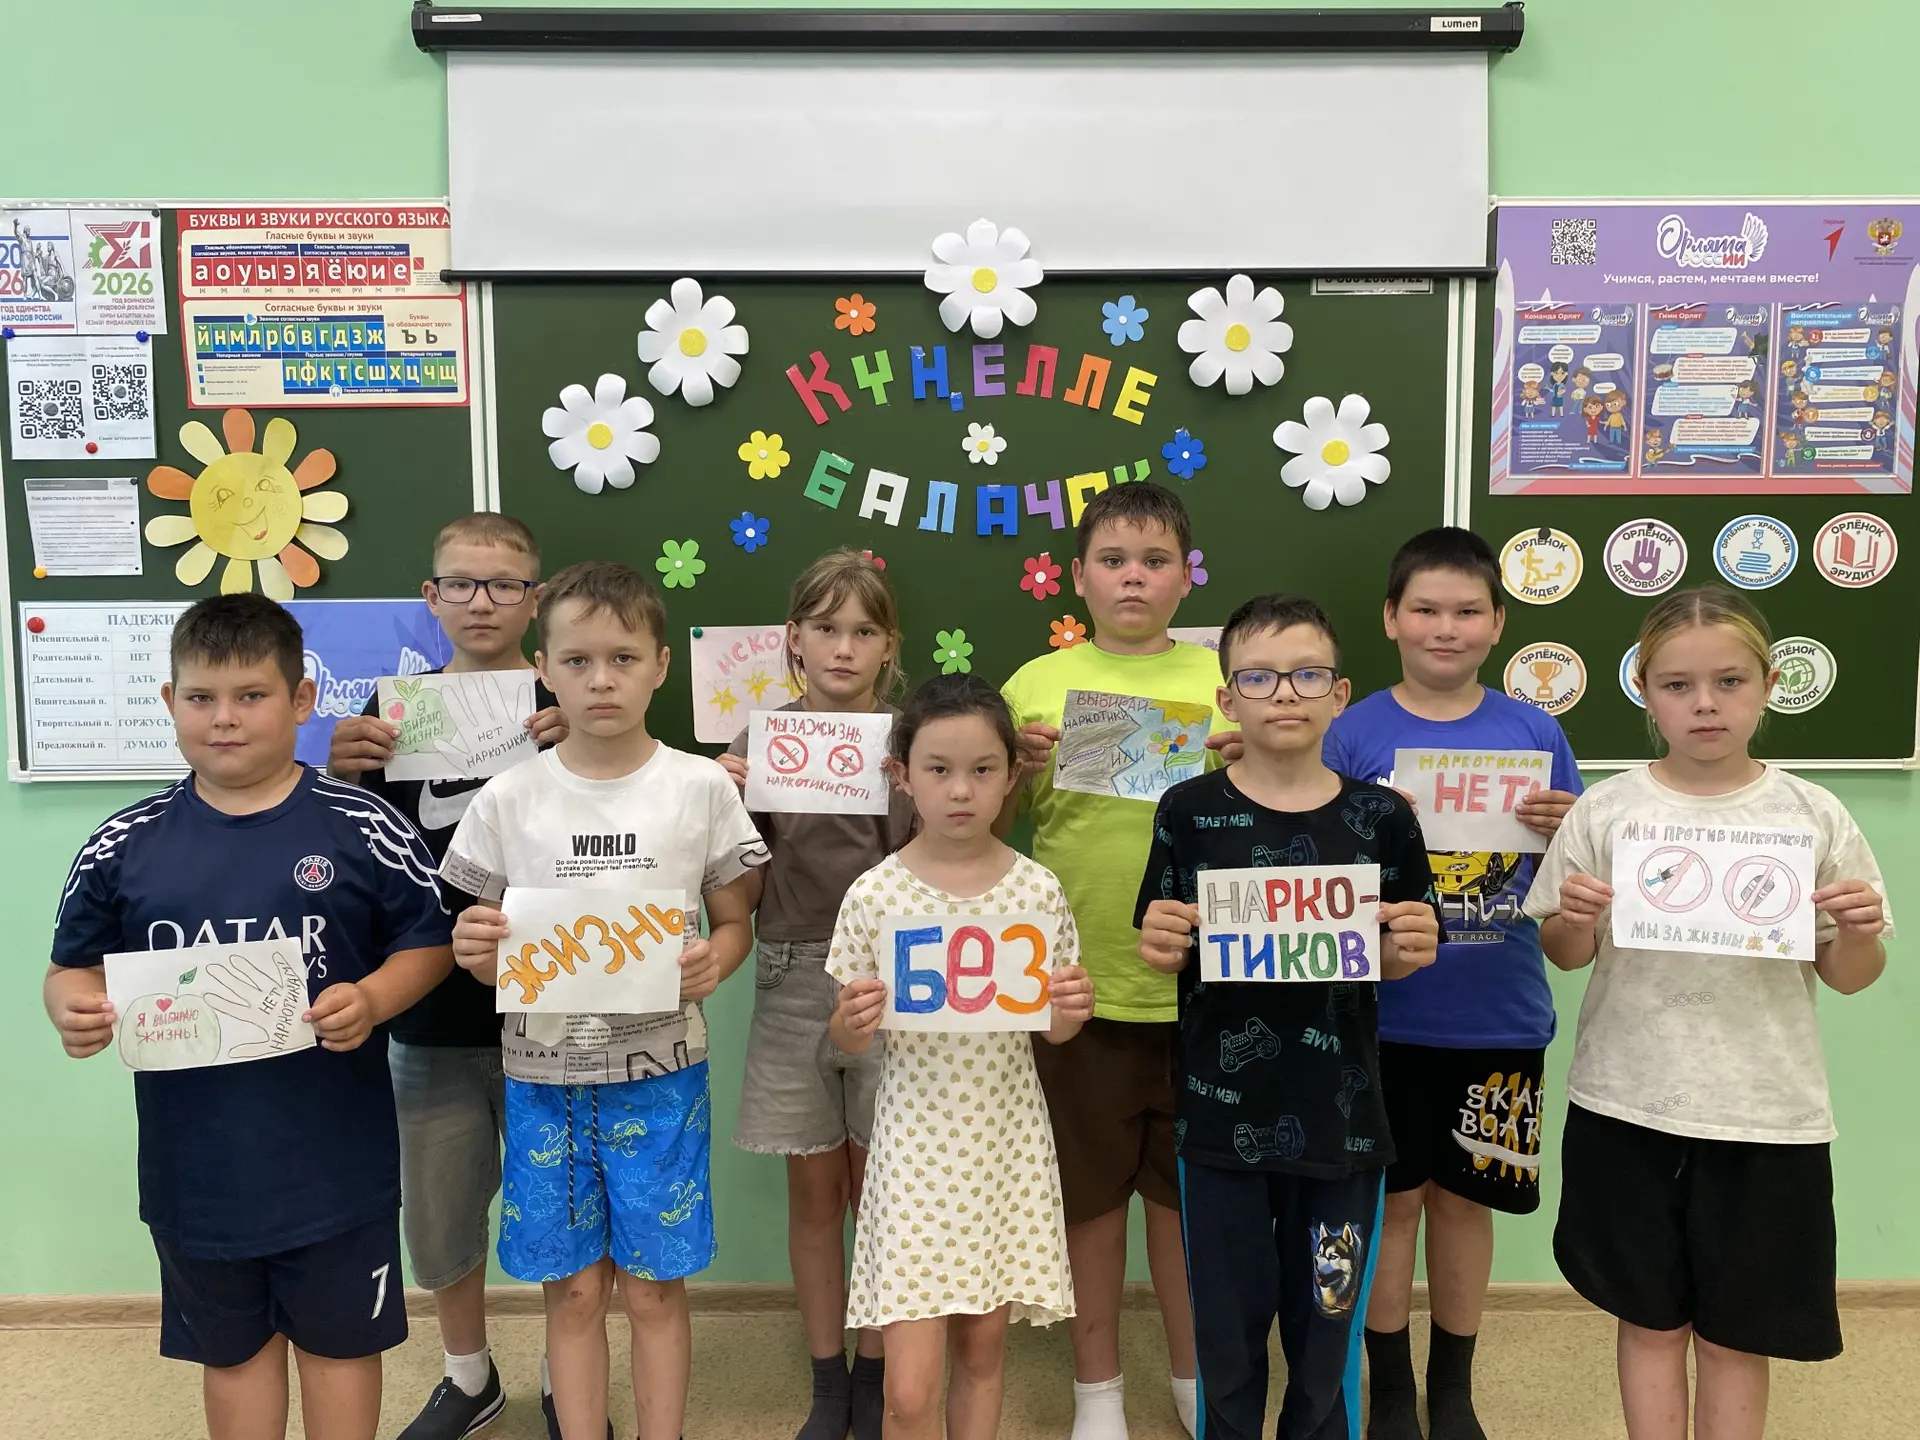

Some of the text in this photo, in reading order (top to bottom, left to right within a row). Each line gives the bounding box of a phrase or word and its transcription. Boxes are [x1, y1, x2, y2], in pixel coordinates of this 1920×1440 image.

[189, 212, 450, 227] БУКВЫ И ЗВУКИ РУССКОГО ЯЗЫКА
[266, 231, 304, 241] Гласные
[307, 231, 336, 242] буквы
[348, 232, 374, 242] звуки
[92, 272, 153, 295] 2026
[1603, 273, 1819, 286] Учимся, растем, мечтаем вместе!
[1, 305, 51, 313] ГОД ЕДИНСТВА
[265, 303, 314, 312] Согласные
[317, 303, 346, 313] буквы
[357, 304, 383, 313] звуки
[1791, 312, 1852, 320] Воспитательные
[1, 313, 62, 322] НАРОДОВ РОССИИ
[1831, 519, 1885, 538] ОРЛЁНОК
[1757, 522, 1791, 553] ХРАНИТЕЛЬ
[1612, 564, 1675, 588] ДОБРОВОЛЕЦ
[1721, 556, 1788, 583] ИСТОРИЧЕСКОЙ ПАМЯТИ
[1830, 567, 1876, 581] ЭРУДИТ
[1520, 585, 1560, 598] ЛИДЕР
[107, 614, 174, 627] ПАДЕЖИ
[31, 634, 99, 643] Именительный
[129, 634, 150, 643] ЭТО
[32, 653, 92, 662] Родительный
[130, 653, 151, 661] НЕТ
[716, 631, 782, 676] ИСКО
[1520, 648, 1573, 666] ОРЛЁНОК
[1771, 645, 1816, 663] РЛЁНОК
[33, 675, 83, 685] Дательный
[127, 675, 156, 684] ДАТЬ
[34, 696, 95, 705] Винительный
[127, 696, 159, 705] ВИЖУ
[1513, 687, 1577, 709] СПОРТСМЕН
[1777, 685, 1821, 705] ЭКОЛОГ
[416, 700, 427, 716] Я
[37, 719, 101, 729] Творительный
[118, 719, 171, 727] ГОРЖУСЬ
[401, 710, 443, 733] БИРАЮ
[765, 716, 788, 732] МЫ
[37, 741, 95, 750] Предложный
[124, 740, 167, 749] ДУМАЮ
[1418, 754, 1544, 770] НАРКОТИКАМ
[1230, 814, 1254, 827] NEW
[1664, 826, 1726, 842] ПРОТИВ
[572, 833, 636, 856] WORLD
[302, 857, 329, 867] PARIS
[1207, 876, 1378, 924] НАРКО-
[147, 915, 326, 952] QATAR
[1662, 925, 1682, 941] ЗА
[1687, 928, 1745, 948] ЖИЗНЬ!
[499, 903, 686, 1004] ЖИЗНЬ
[1207, 930, 1370, 980] ТИКОВ
[258, 987, 281, 1015] НЕТ
[137, 1009, 199, 1027] Я ВЫБИРАЮ
[136, 1029, 198, 1043] ЖИЗНЬ!
[1466, 1084, 1544, 1113] SKAT
[1459, 1108, 1541, 1143] BOAR
[371, 1262, 390, 1320] 7
